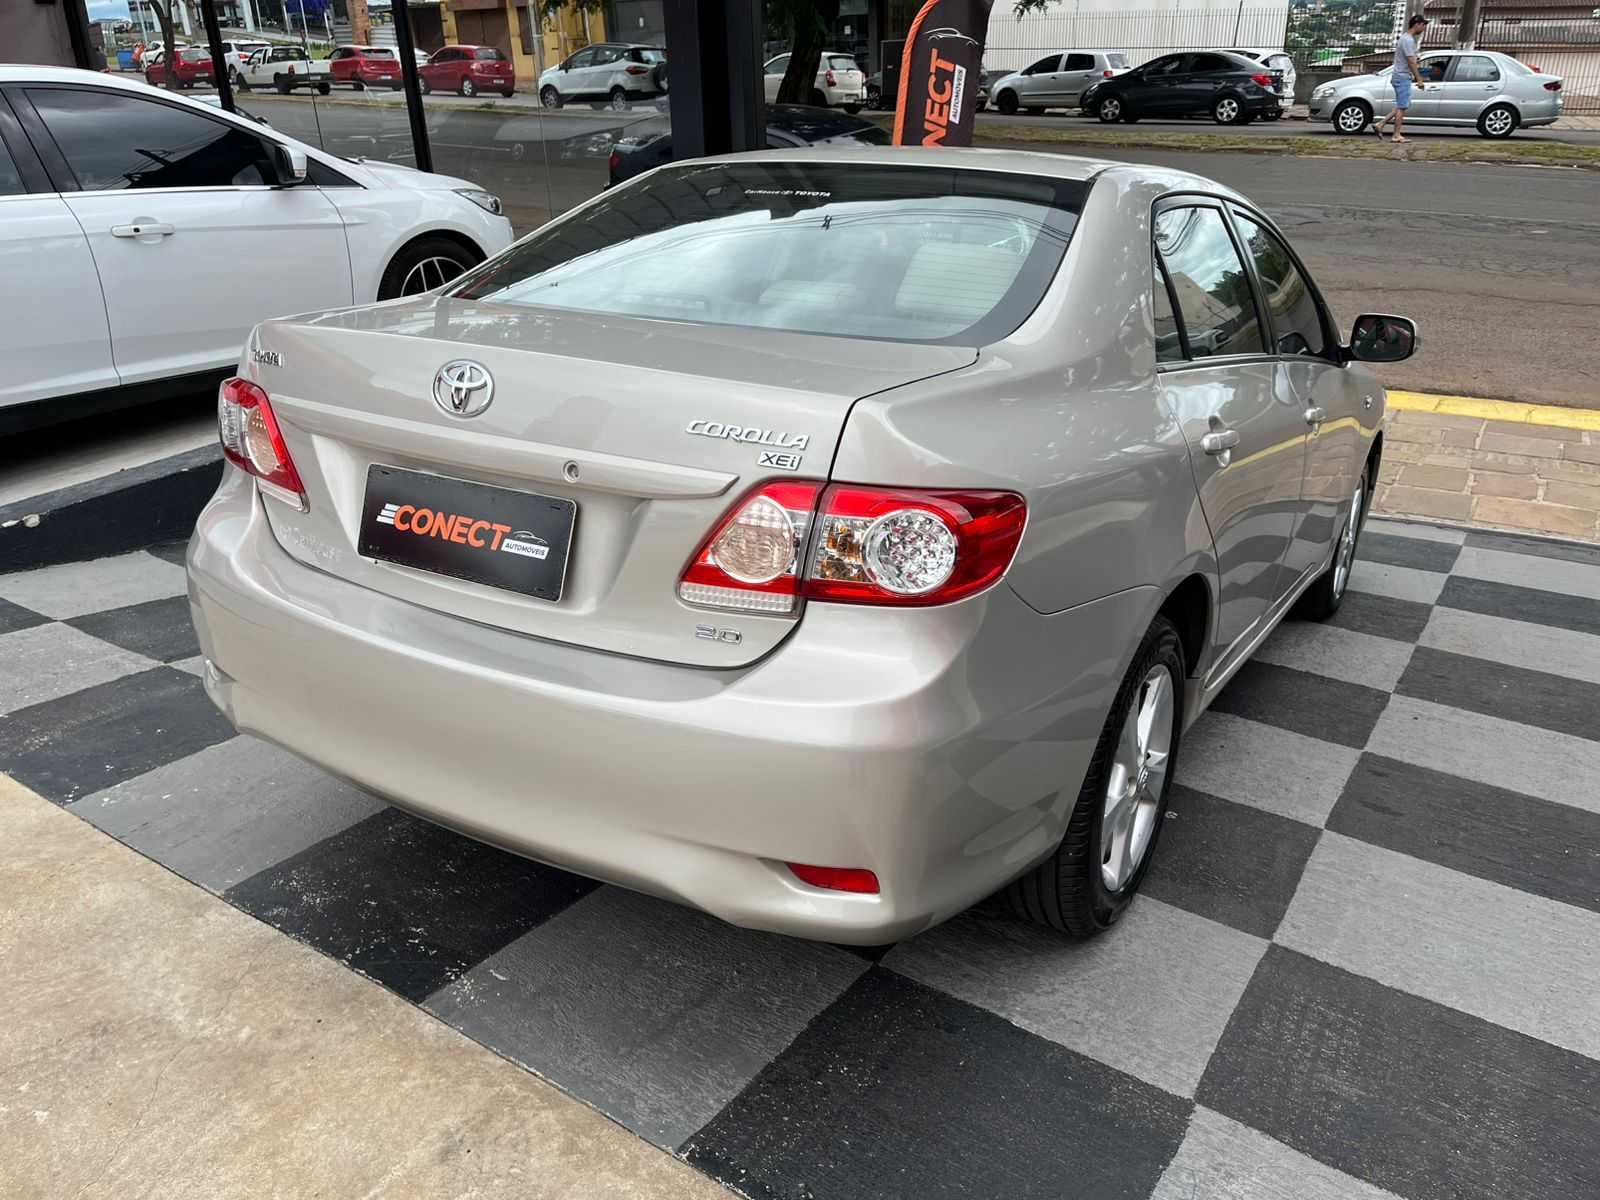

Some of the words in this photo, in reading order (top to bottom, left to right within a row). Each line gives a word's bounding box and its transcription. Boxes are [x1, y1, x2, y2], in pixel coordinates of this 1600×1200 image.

[685, 420, 809, 450] COROLLA
[760, 451, 799, 469] XEi
[394, 504, 512, 551] CONECT
[695, 625, 743, 645] 2.0
